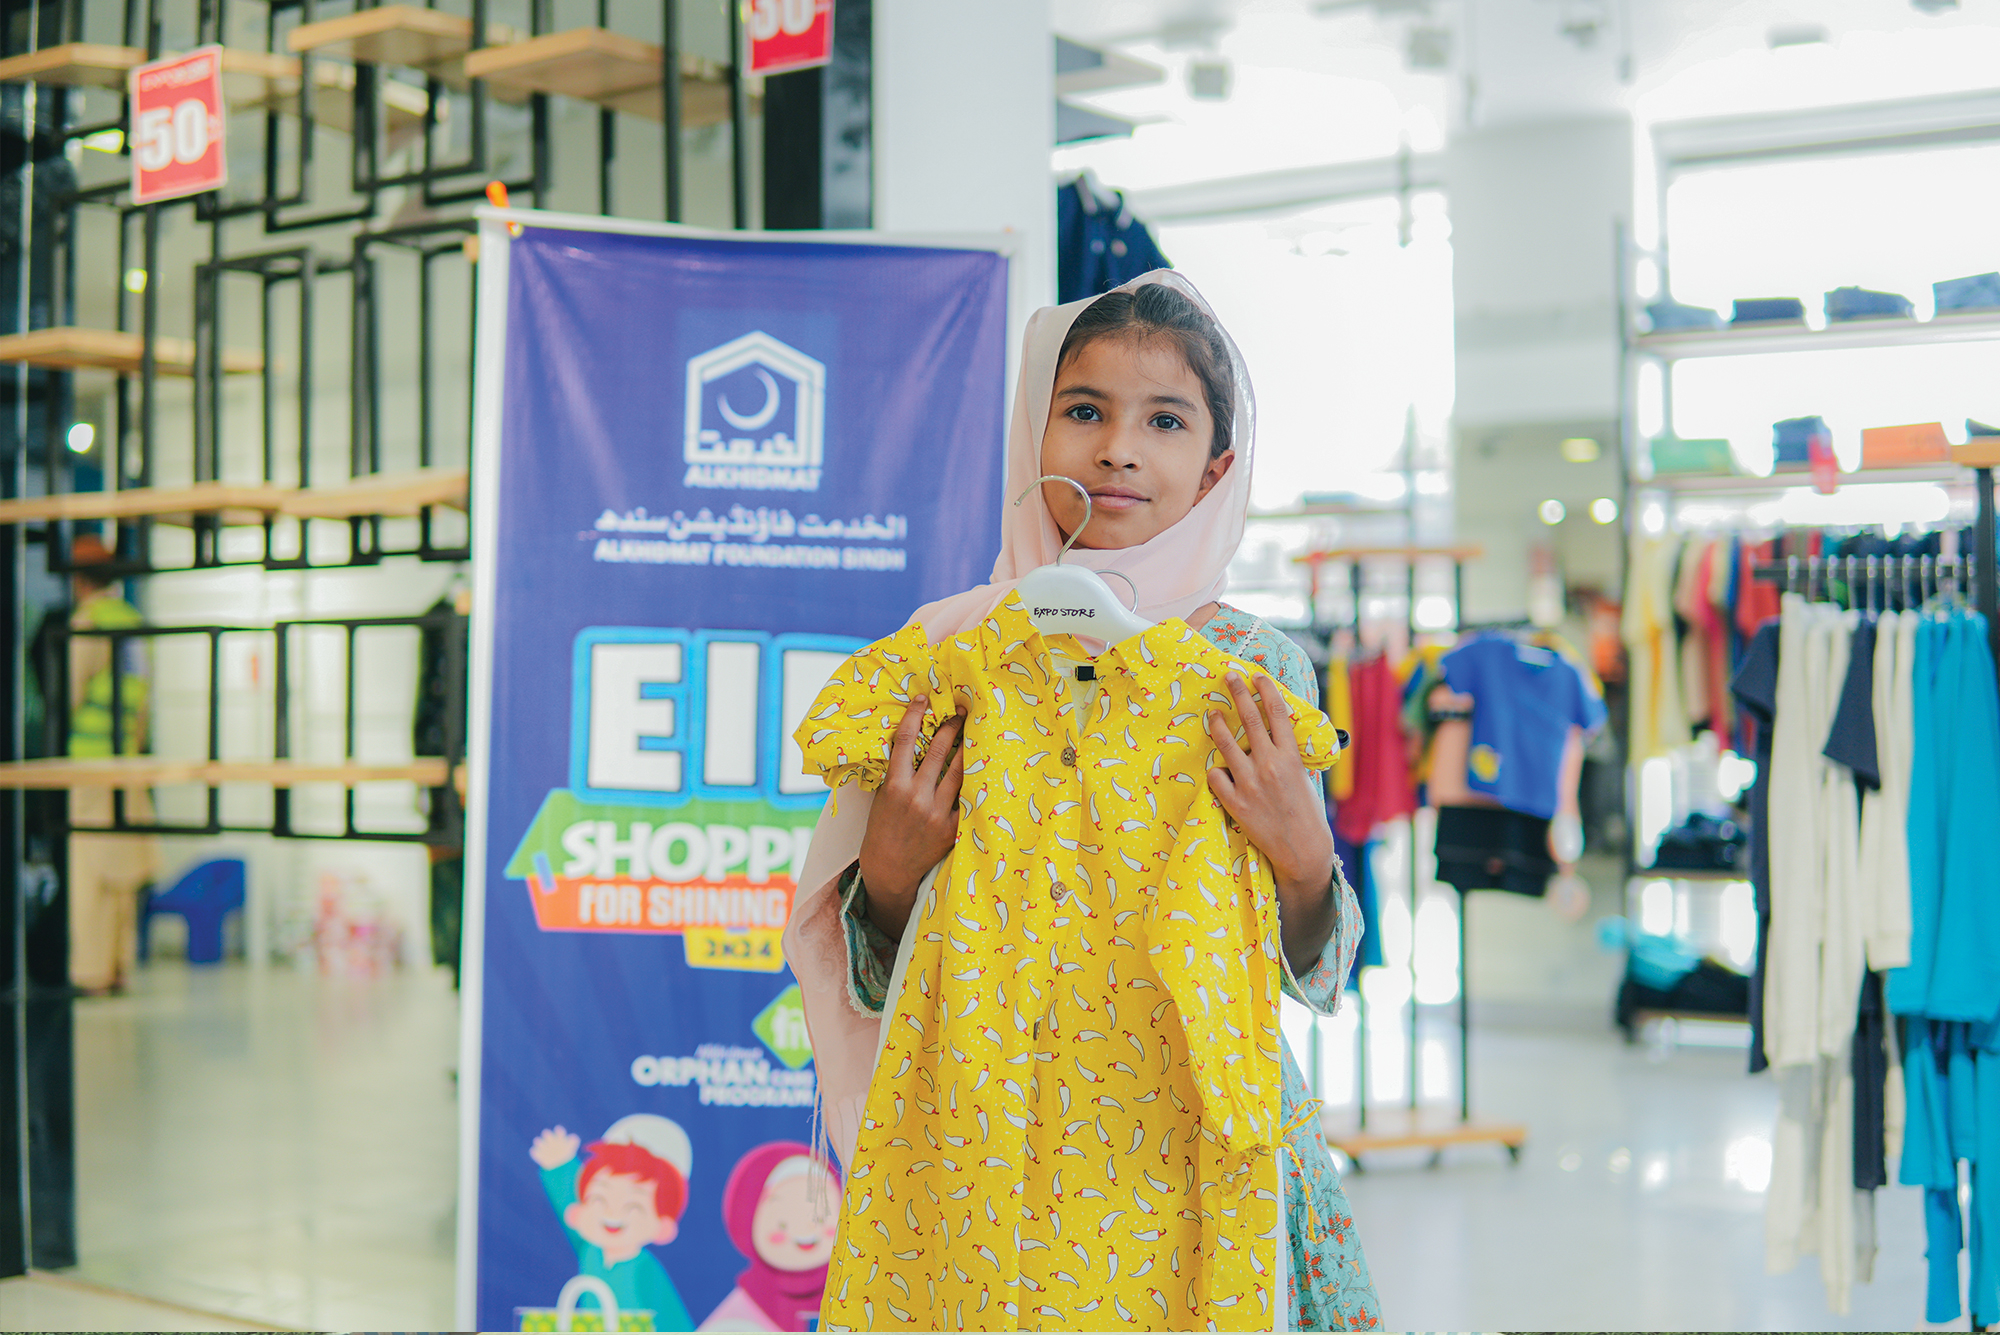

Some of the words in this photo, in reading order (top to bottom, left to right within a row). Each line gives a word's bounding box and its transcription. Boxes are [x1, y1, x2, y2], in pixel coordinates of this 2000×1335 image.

[139, 98, 208, 172] 50
[683, 465, 820, 491] ALKHIDMAT
[594, 538, 711, 566] ALKHIDMAT
[711, 542, 841, 569] FOUNDATION
[841, 546, 907, 572] SINDH
[1034, 607, 1058, 618] EXPO
[1061, 607, 1096, 618] STORE
[578, 884, 642, 925] FOR
[647, 886, 787, 928] SHINING
[631, 1055, 770, 1086] ORPHAN
